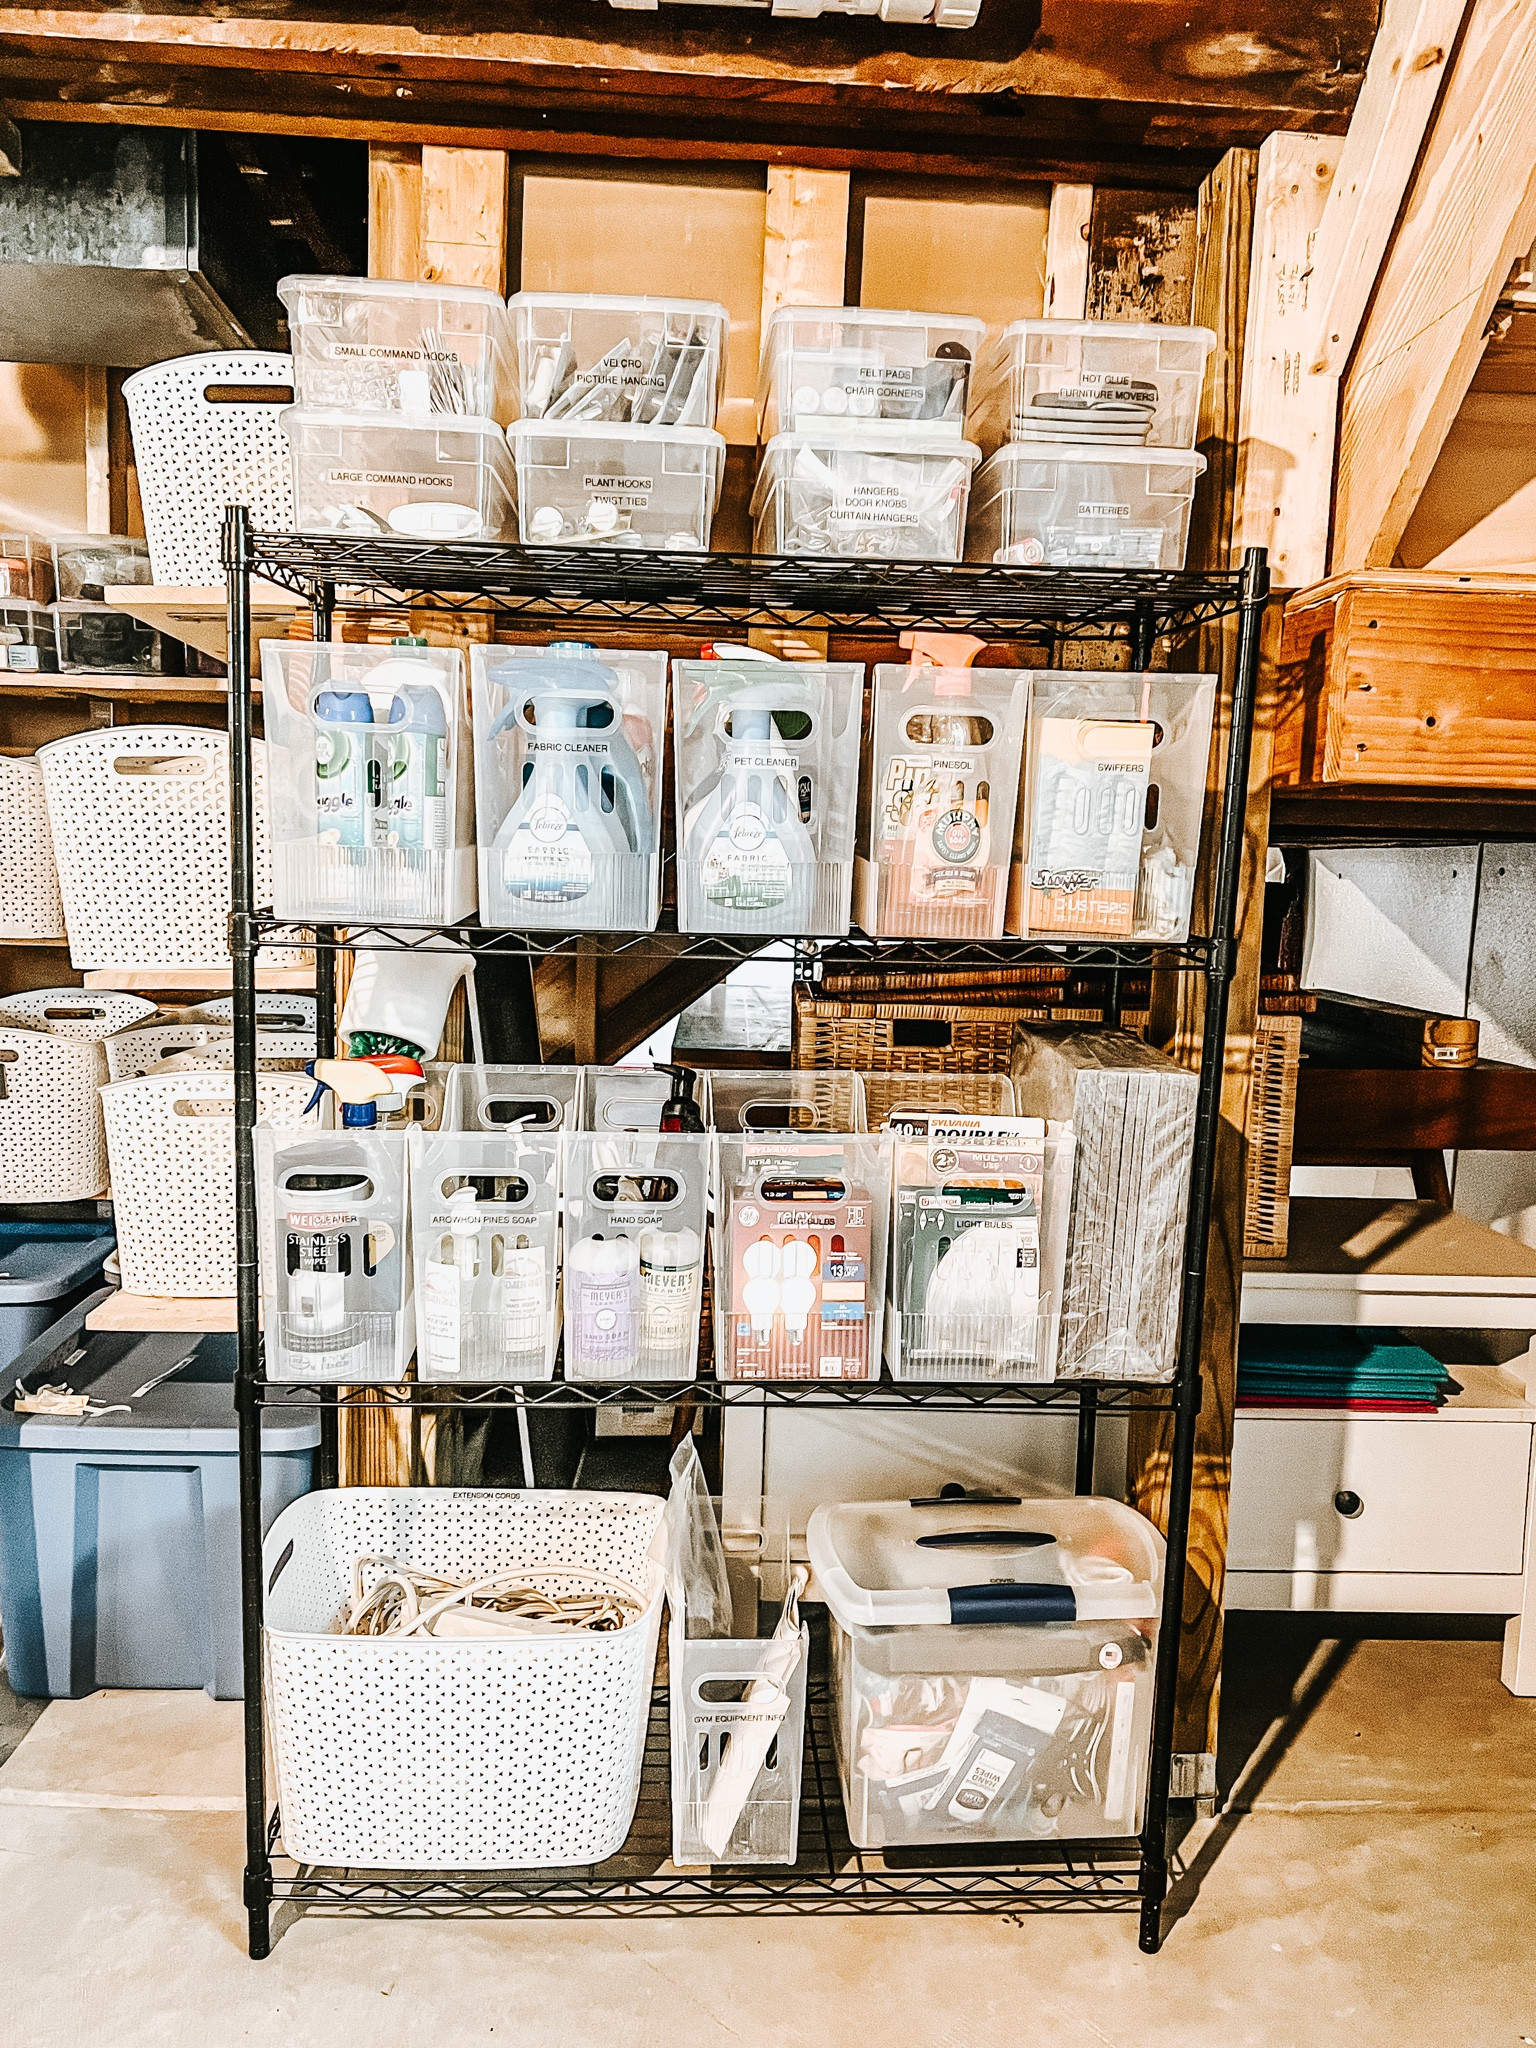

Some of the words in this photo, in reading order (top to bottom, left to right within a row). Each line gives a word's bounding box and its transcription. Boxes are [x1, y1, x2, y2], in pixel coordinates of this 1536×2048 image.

[334, 346, 367, 357] SMALL
[369, 348, 421, 360] COMMAND
[423, 352, 458, 362] HOOKS
[603, 358, 642, 369] VELCRO
[859, 367, 882, 378] FELT
[885, 369, 911, 380] PADS
[576, 374, 618, 385] PICTURE
[620, 376, 665, 387] HANGING
[1082, 374, 1101, 383] HOT
[1104, 375, 1130, 386] GLUE
[845, 386, 874, 396] CHAIR
[876, 388, 924, 399] CORNERS
[1060, 389, 1113, 400] FURNITURE
[1115, 391, 1155, 402] MOVERS
[331, 472, 362, 482] LARGE
[365, 473, 416, 485] COMMAND
[418, 477, 453, 487] HOOKS
[585, 478, 615, 488] PLANT
[617, 480, 652, 489] HOOKS
[853, 486, 900, 497] HANGERS
[593, 495, 623, 506] TWIST
[627, 497, 647, 506] TIES
[845, 497, 873, 507] DOOR
[875, 499, 908, 509] KNOBS
[1078, 505, 1129, 516] BATTERIES
[829, 510, 871, 521] CURTAIN
[873, 513, 919, 524] HANGERS
[527, 742, 562, 752] FABRIC
[564, 743, 608, 753] CLEANER
[735, 756, 752, 766] PET
[755, 757, 797, 767] CLEANER
[933, 760, 972, 770] PINESOL
[1097, 763, 1144, 773] SWIFFERS
[727, 854, 768, 862] FABRIC
[931, 1119, 981, 1128] SYLVANIA
[848, 1207, 864, 1220] HD
[315, 1215, 357, 1224] CLEANER
[483, 1215, 510, 1224] PINES
[512, 1215, 537, 1224] SOAP
[610, 1216, 635, 1225] HAND
[637, 1216, 662, 1225] SOAP
[956, 1220, 982, 1228] LIGHT
[984, 1220, 1013, 1229] BULBS
[288, 1233, 347, 1246] STAINLESS
[299, 1246, 334, 1257] STEEL
[303, 1257, 330, 1266] WIPES
[830, 1264, 844, 1277] 13
[590, 1289, 629, 1302] MEYER'S
[494, 1492, 521, 1500] CORDS
[694, 1716, 713, 1724] GYM
[715, 1715, 763, 1723] EQUIPMENT
[765, 1714, 785, 1722] INFO
[975, 1767, 1001, 1783] WIPES
